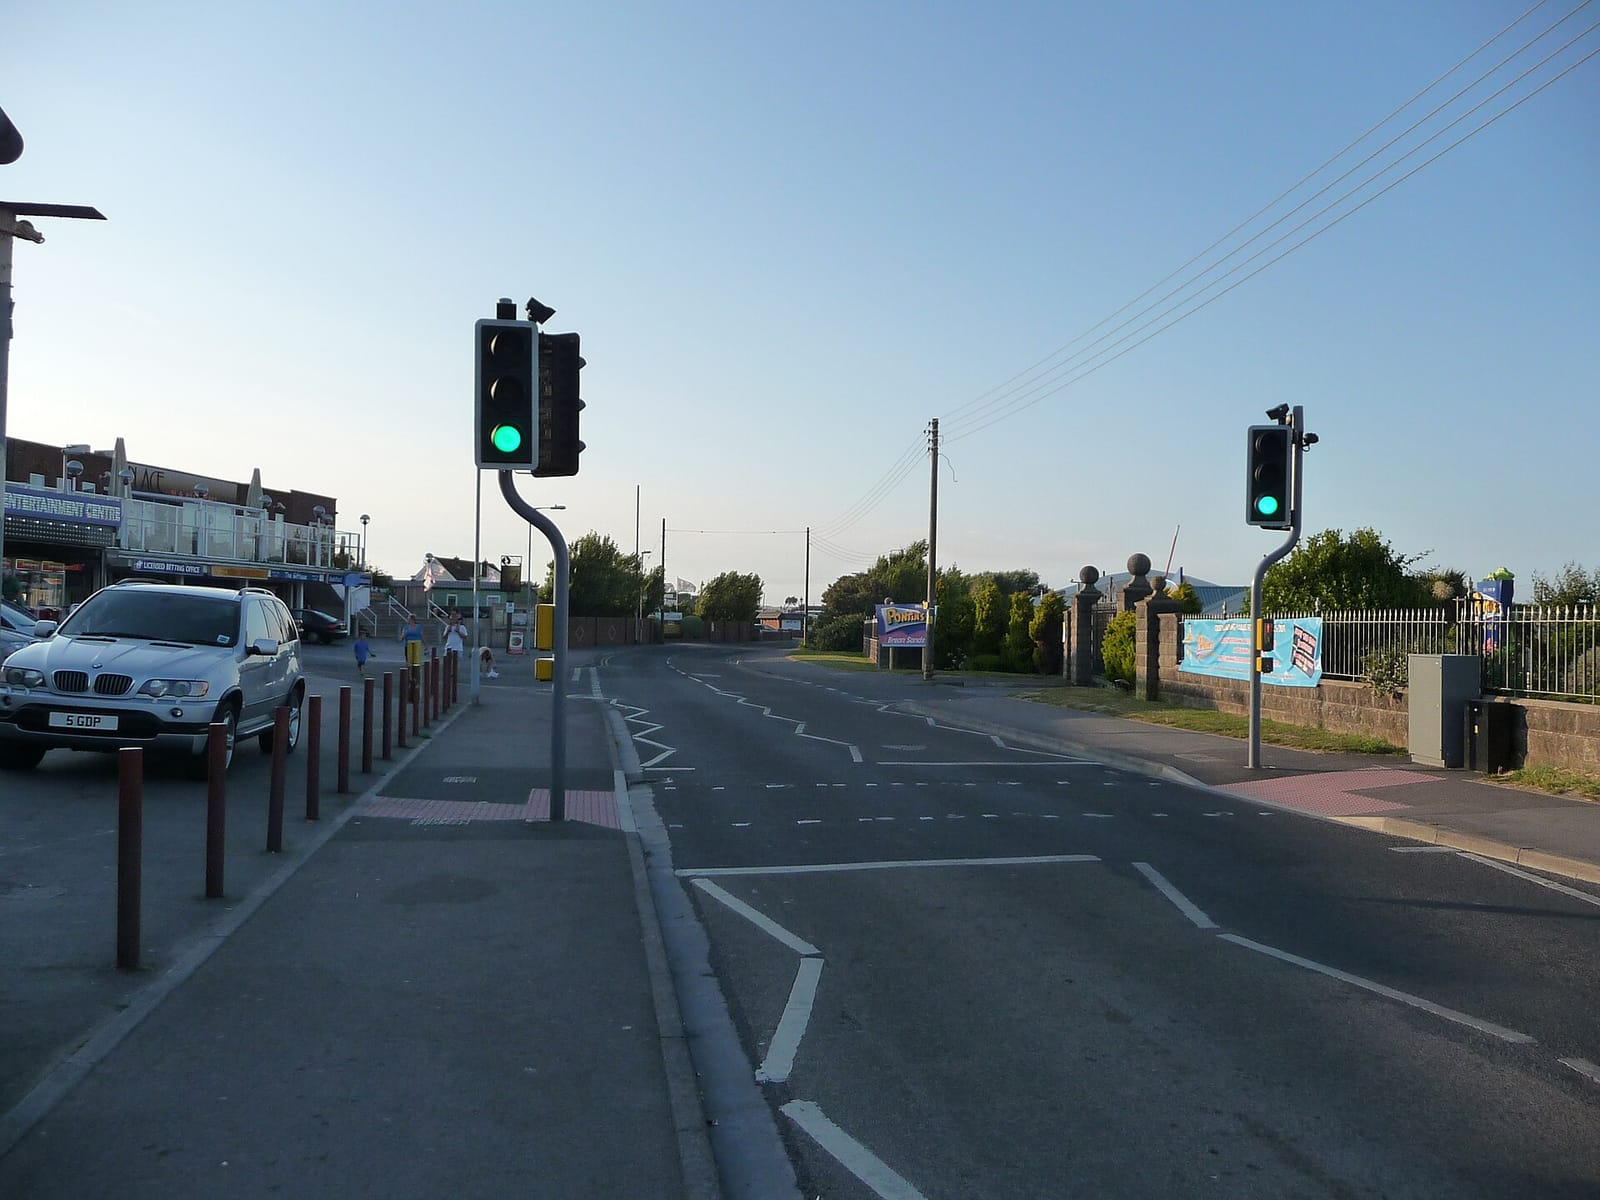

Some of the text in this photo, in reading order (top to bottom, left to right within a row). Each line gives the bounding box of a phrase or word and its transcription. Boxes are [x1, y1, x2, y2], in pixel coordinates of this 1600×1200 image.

[85, 503, 120, 521] CENTRE
[143, 561, 201, 573] LICENSED BETTING OFFICE
[66, 715, 101, 727] 5 GDP
